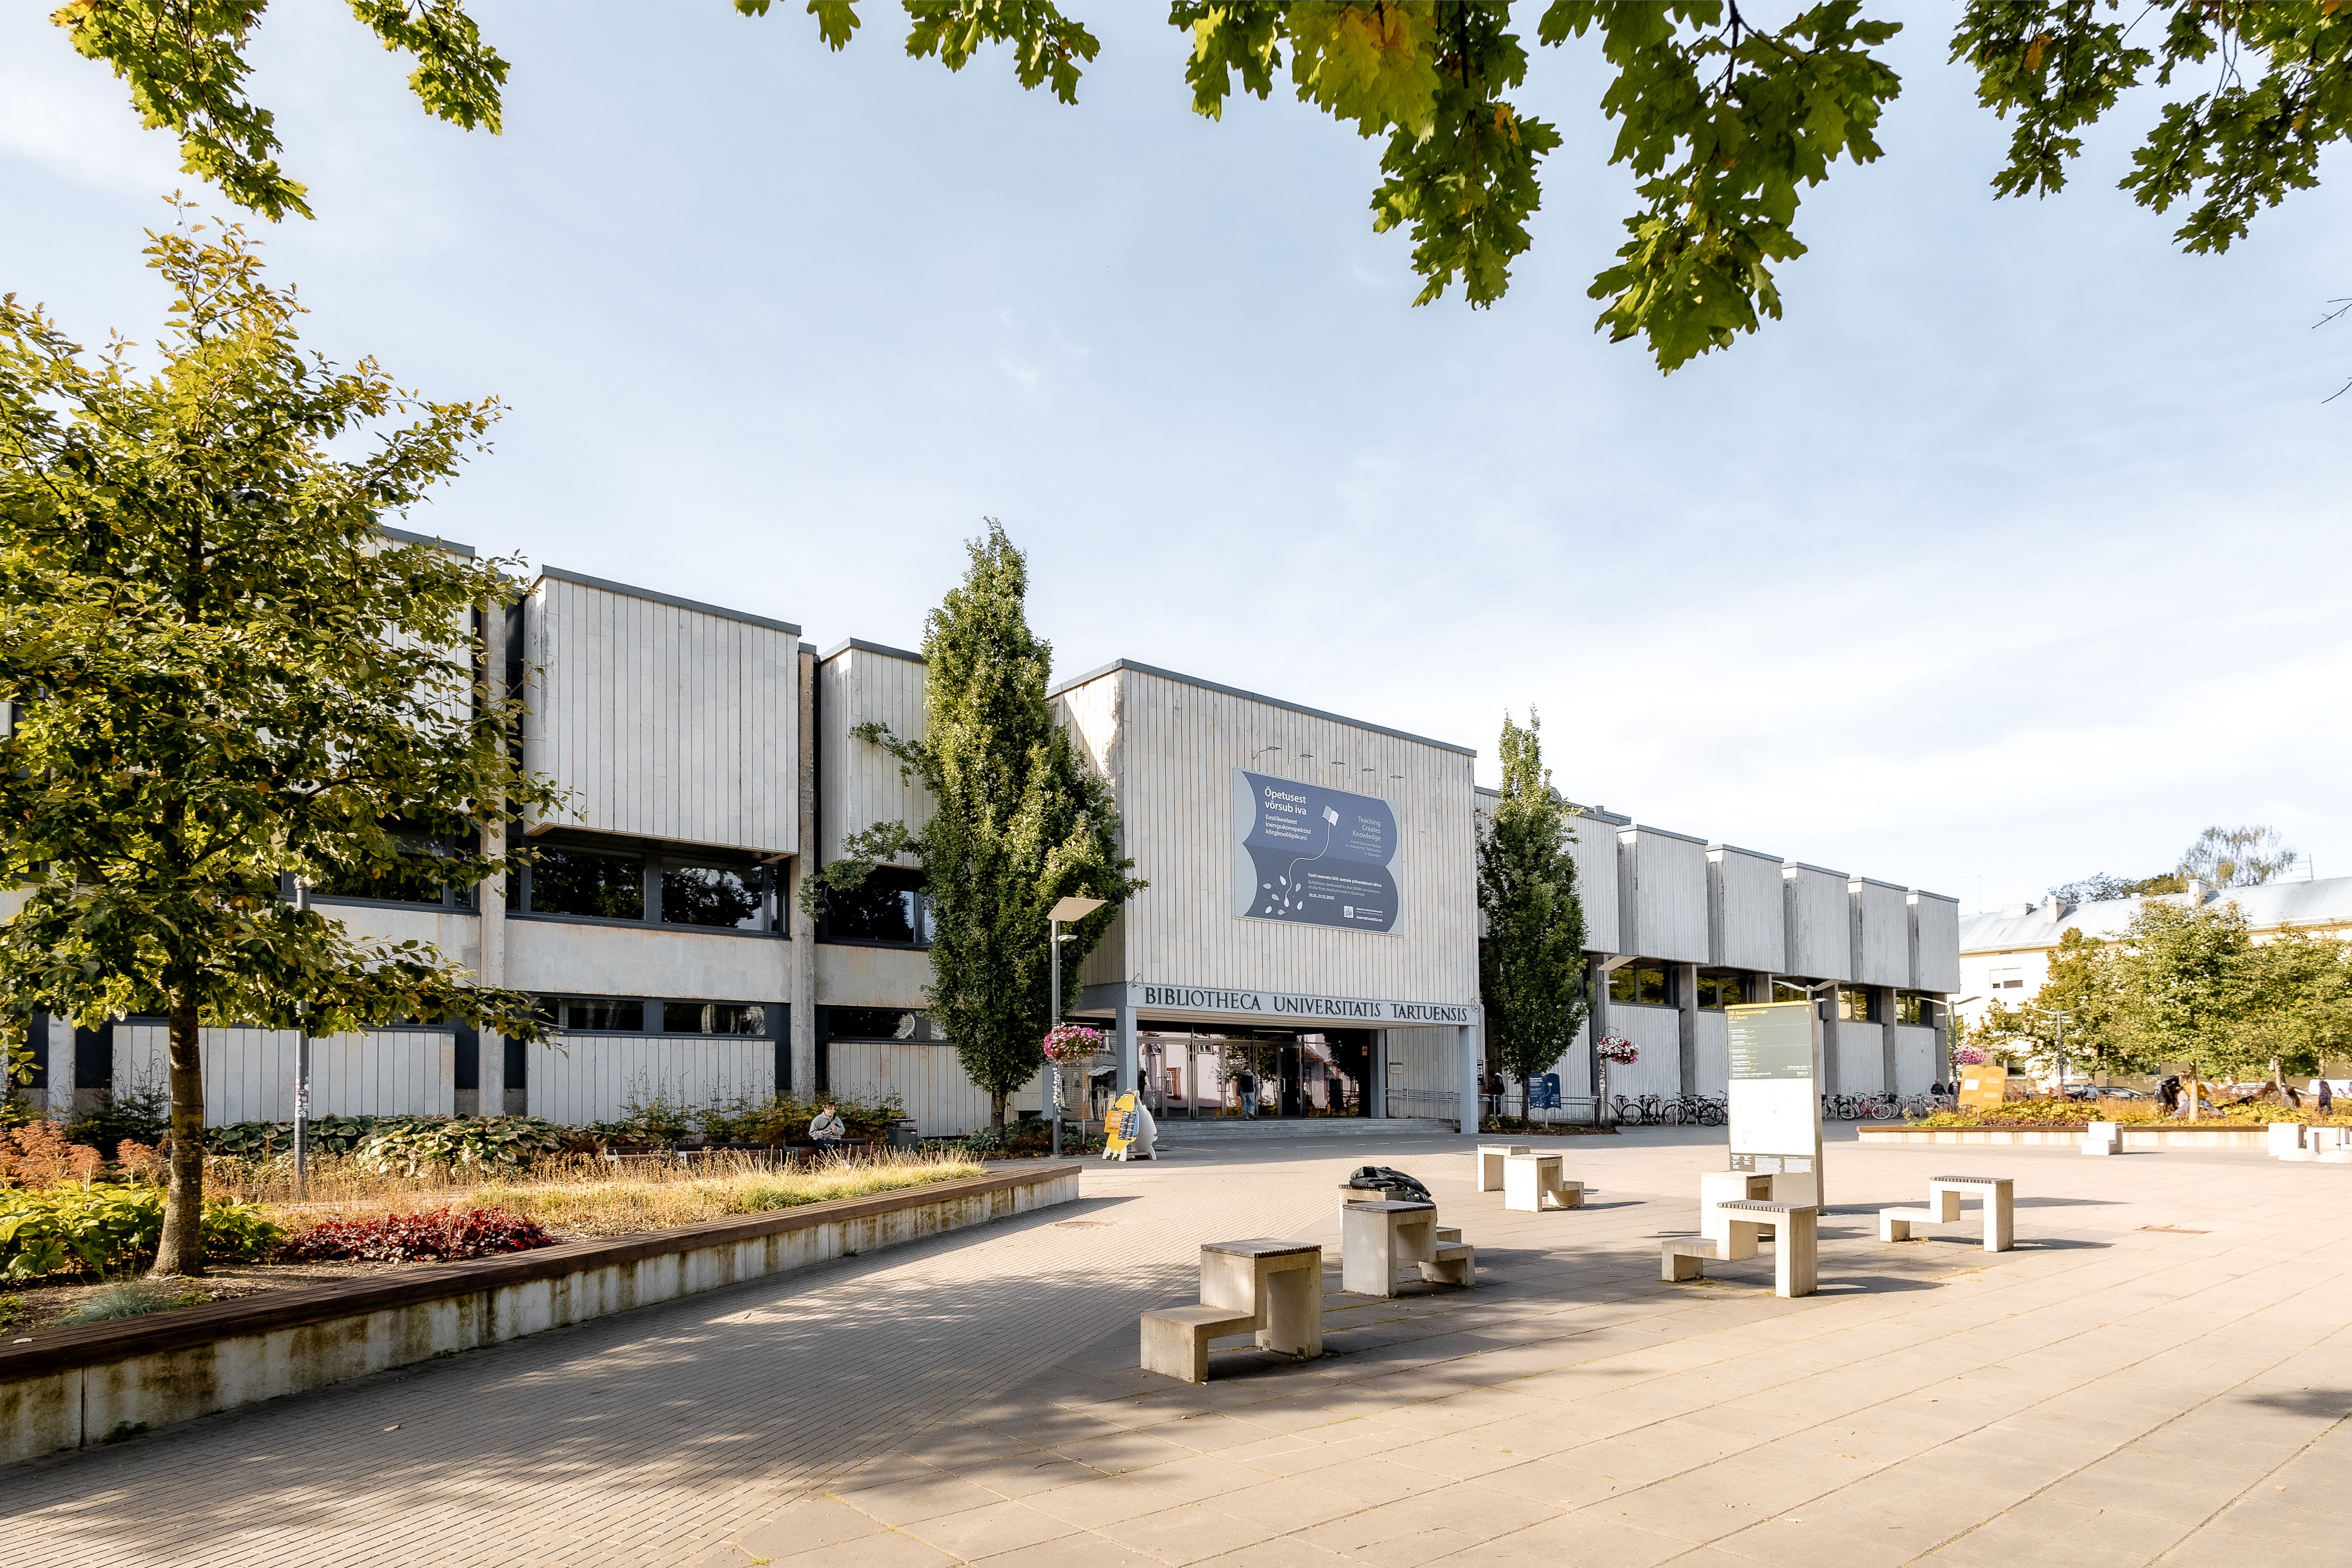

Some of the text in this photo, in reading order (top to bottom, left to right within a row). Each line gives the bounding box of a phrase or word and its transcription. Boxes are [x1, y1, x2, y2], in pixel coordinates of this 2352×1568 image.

[1265, 786, 1306, 804] Õpetusest
[1265, 800, 1307, 815] võrsub iva
[1265, 814, 1298, 825] Eestikeelsest
[1358, 816, 1381, 827] Teaching
[1265, 820, 1312, 835] loengukonspektist
[1362, 824, 1381, 834] Creates
[1265, 828, 1307, 841] kõrgkooliõpikuni
[1352, 830, 1381, 842] Knowledge
[1145, 986, 1467, 1022] BIBLIOTHECA UNIVERSITATIS TARTUENSIS
